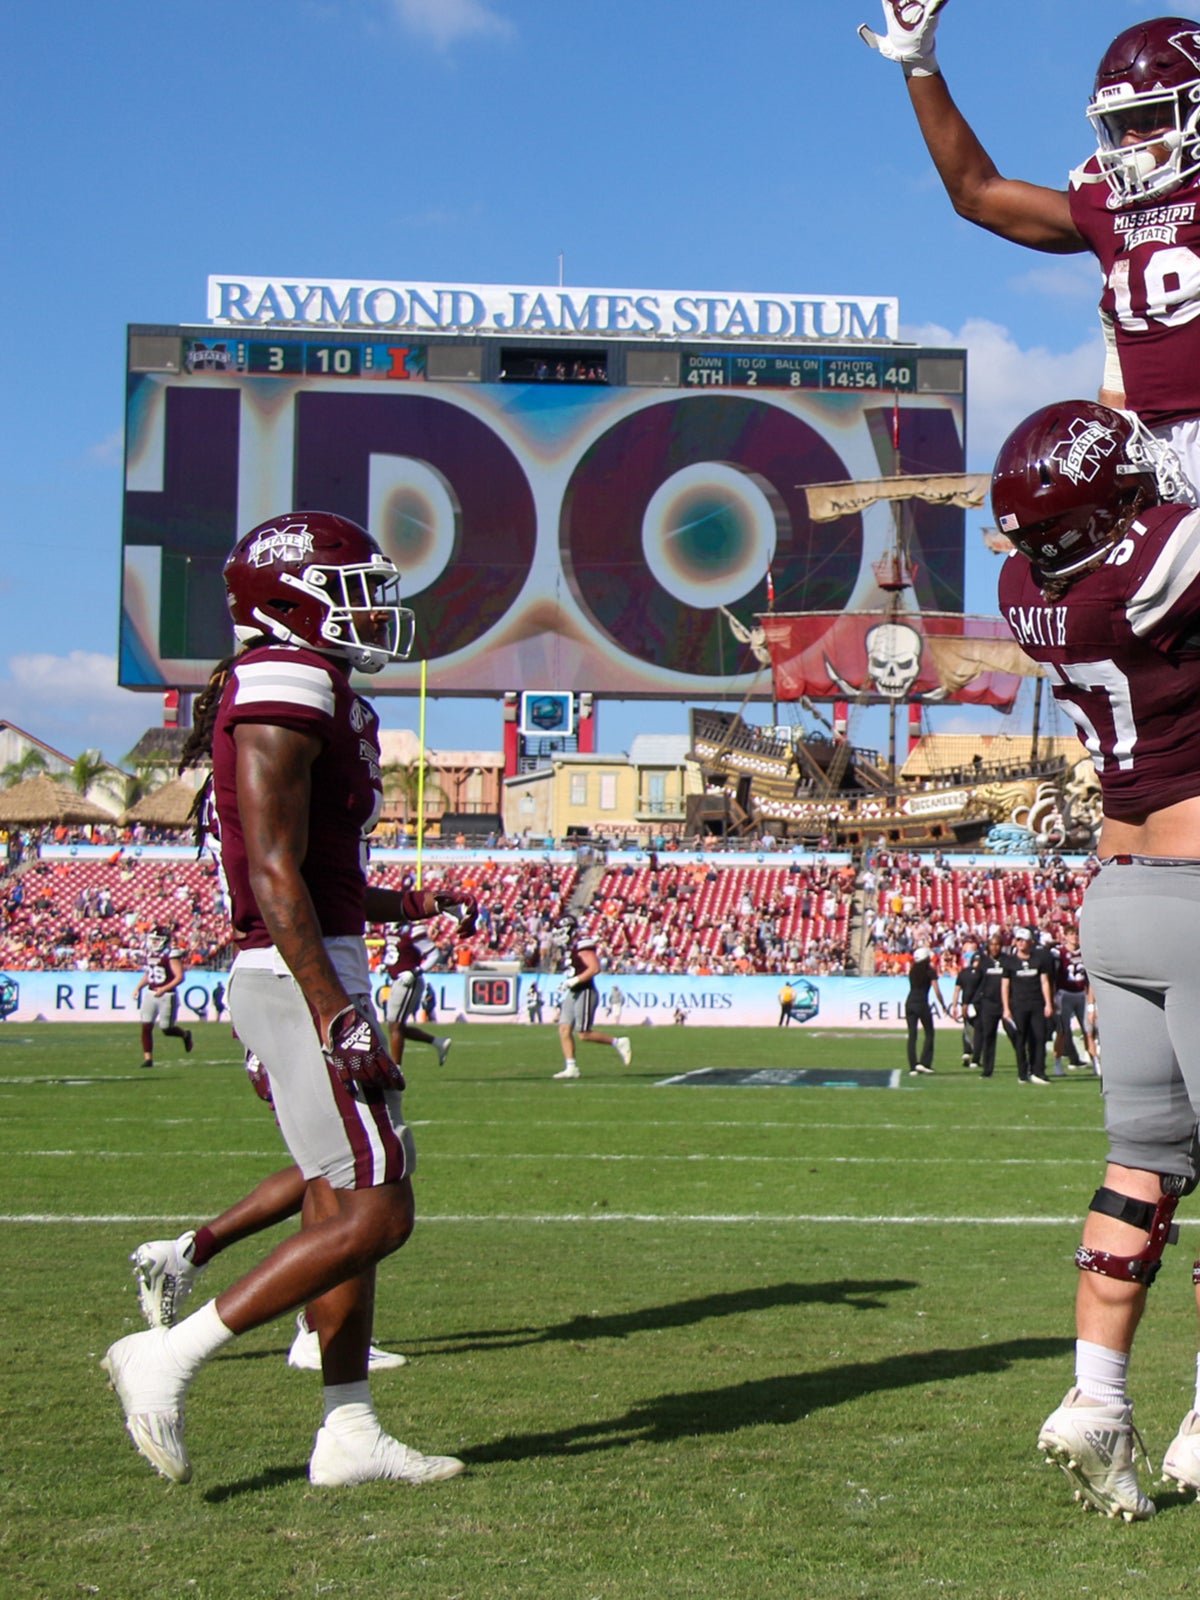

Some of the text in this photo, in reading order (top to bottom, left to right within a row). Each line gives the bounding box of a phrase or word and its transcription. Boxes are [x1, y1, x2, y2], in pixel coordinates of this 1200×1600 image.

[1114, 206, 1196, 230] MISSISSIPPI
[1130, 229, 1168, 246] STATE
[216, 282, 891, 339] RAYMOND JAMES STADIUM
[268, 347, 284, 372] 3
[316, 348, 351, 373] 10
[689, 356, 722, 368] DOWN
[737, 358, 767, 369] TO GO
[775, 360, 819, 370] BALL ON
[829, 361, 874, 372] 4TH QTR
[687, 369, 724, 385] 4TH
[746, 370, 758, 386] 2
[790, 372, 801, 386] 8
[827, 372, 878, 388] 14:54
[884, 367, 911, 385] 40
[1068, 428, 1101, 468] STATE
[257, 534, 300, 551] STATE
[1008, 606, 1068, 646] SMITH
[475, 980, 507, 1006] 40
[662, 992, 733, 1010] JAMES
[340, 1021, 370, 1050] adidas
